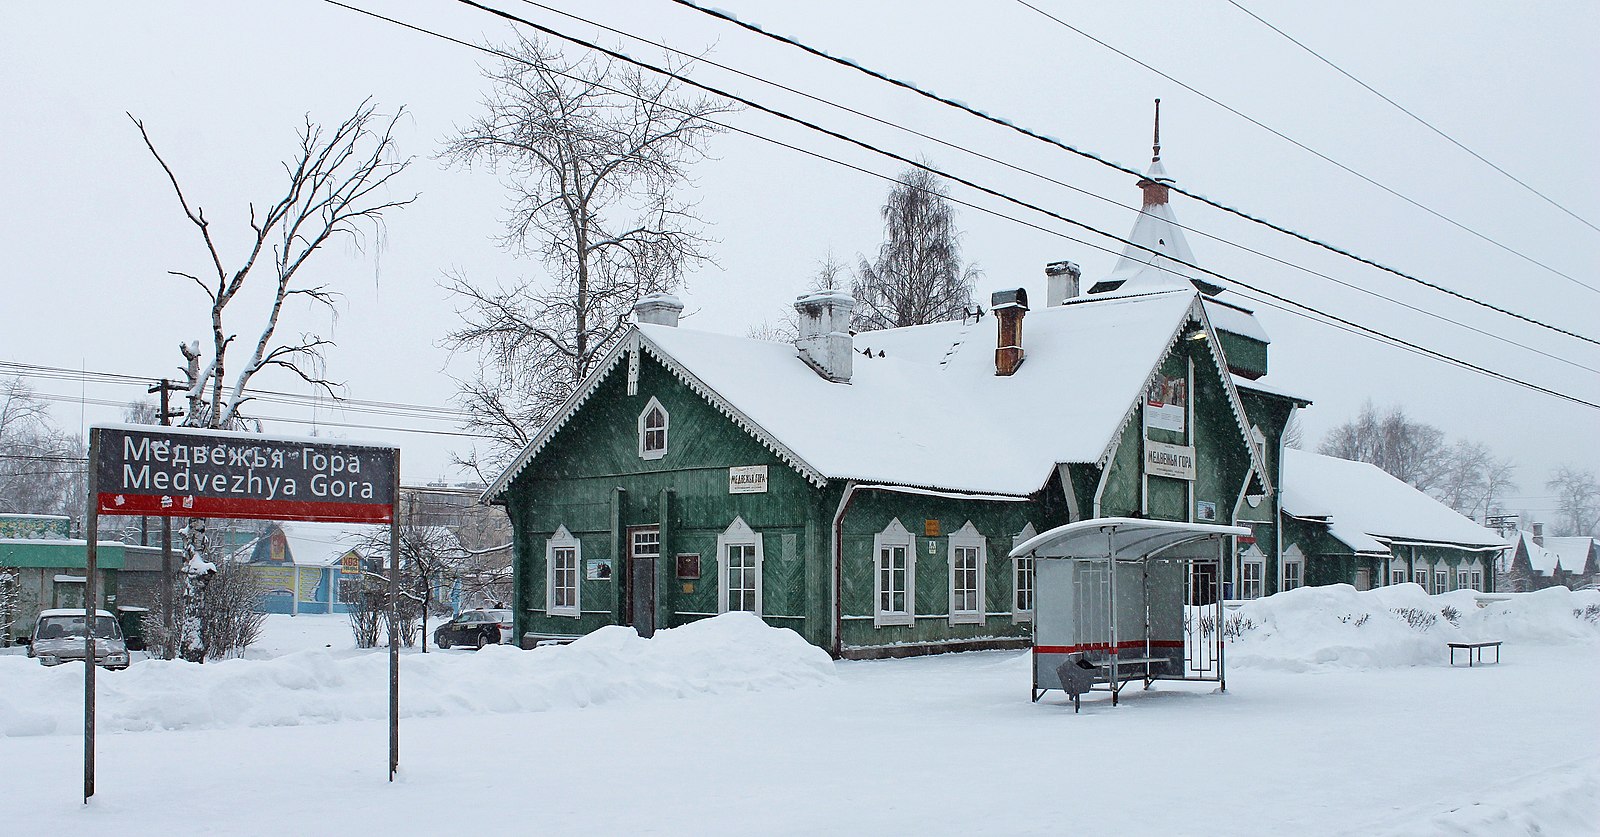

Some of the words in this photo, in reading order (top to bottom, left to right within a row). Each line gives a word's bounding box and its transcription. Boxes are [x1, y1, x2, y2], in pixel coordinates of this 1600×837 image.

[123, 436, 285, 469] Медвежья
[302, 447, 361, 477] Гора
[123, 464, 297, 500] Medvezhya
[310, 474, 374, 499] Gora
